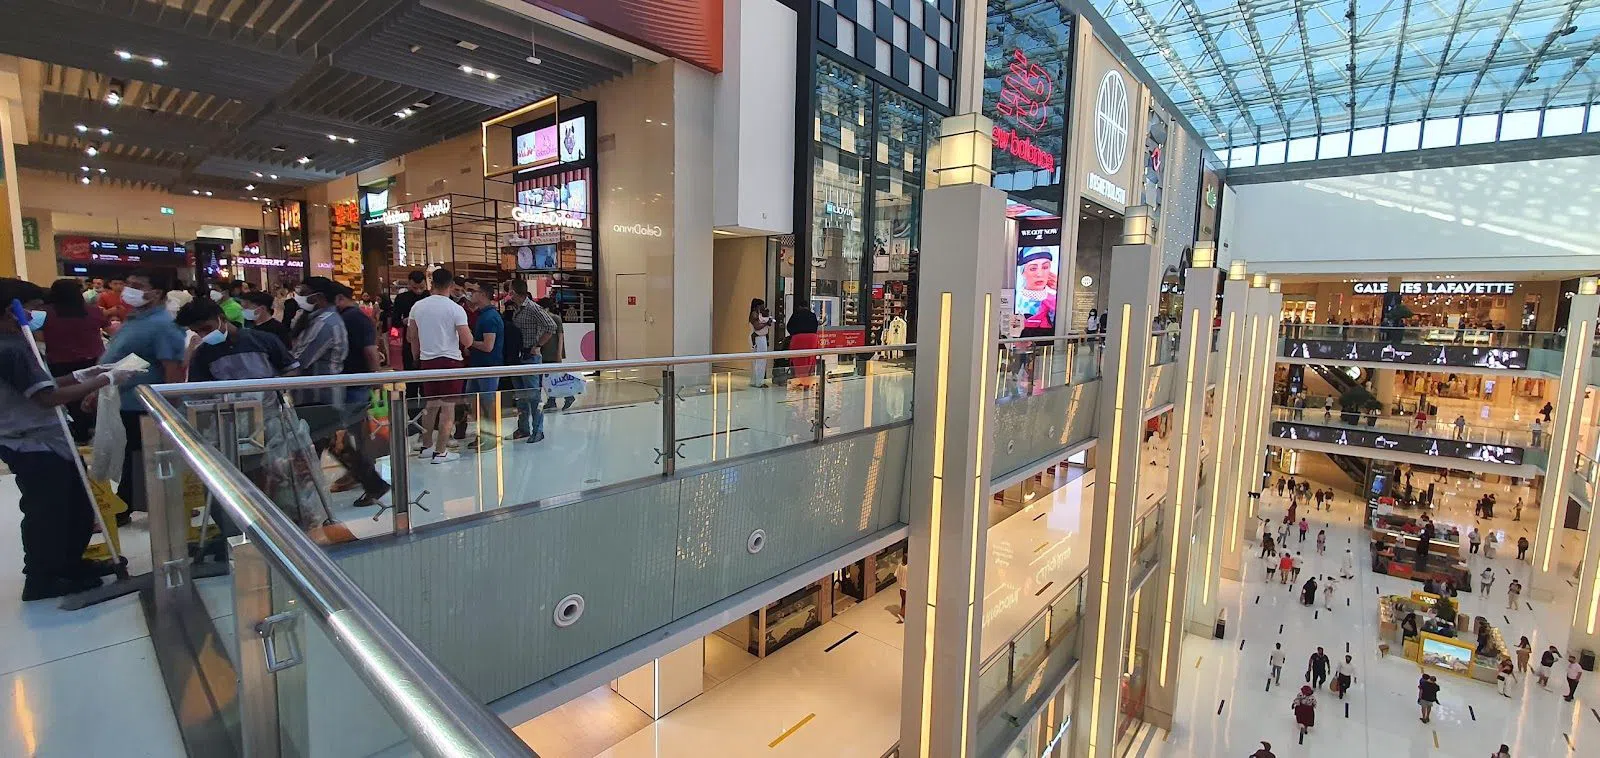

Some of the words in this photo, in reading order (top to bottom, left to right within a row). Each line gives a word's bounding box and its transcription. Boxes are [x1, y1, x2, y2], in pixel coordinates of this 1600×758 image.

[992, 125, 1010, 150] ew
[1010, 129, 1055, 172] balance
[237, 257, 285, 267] OAKBERRY
[1427, 282, 1515, 294] LAFAYETTE
